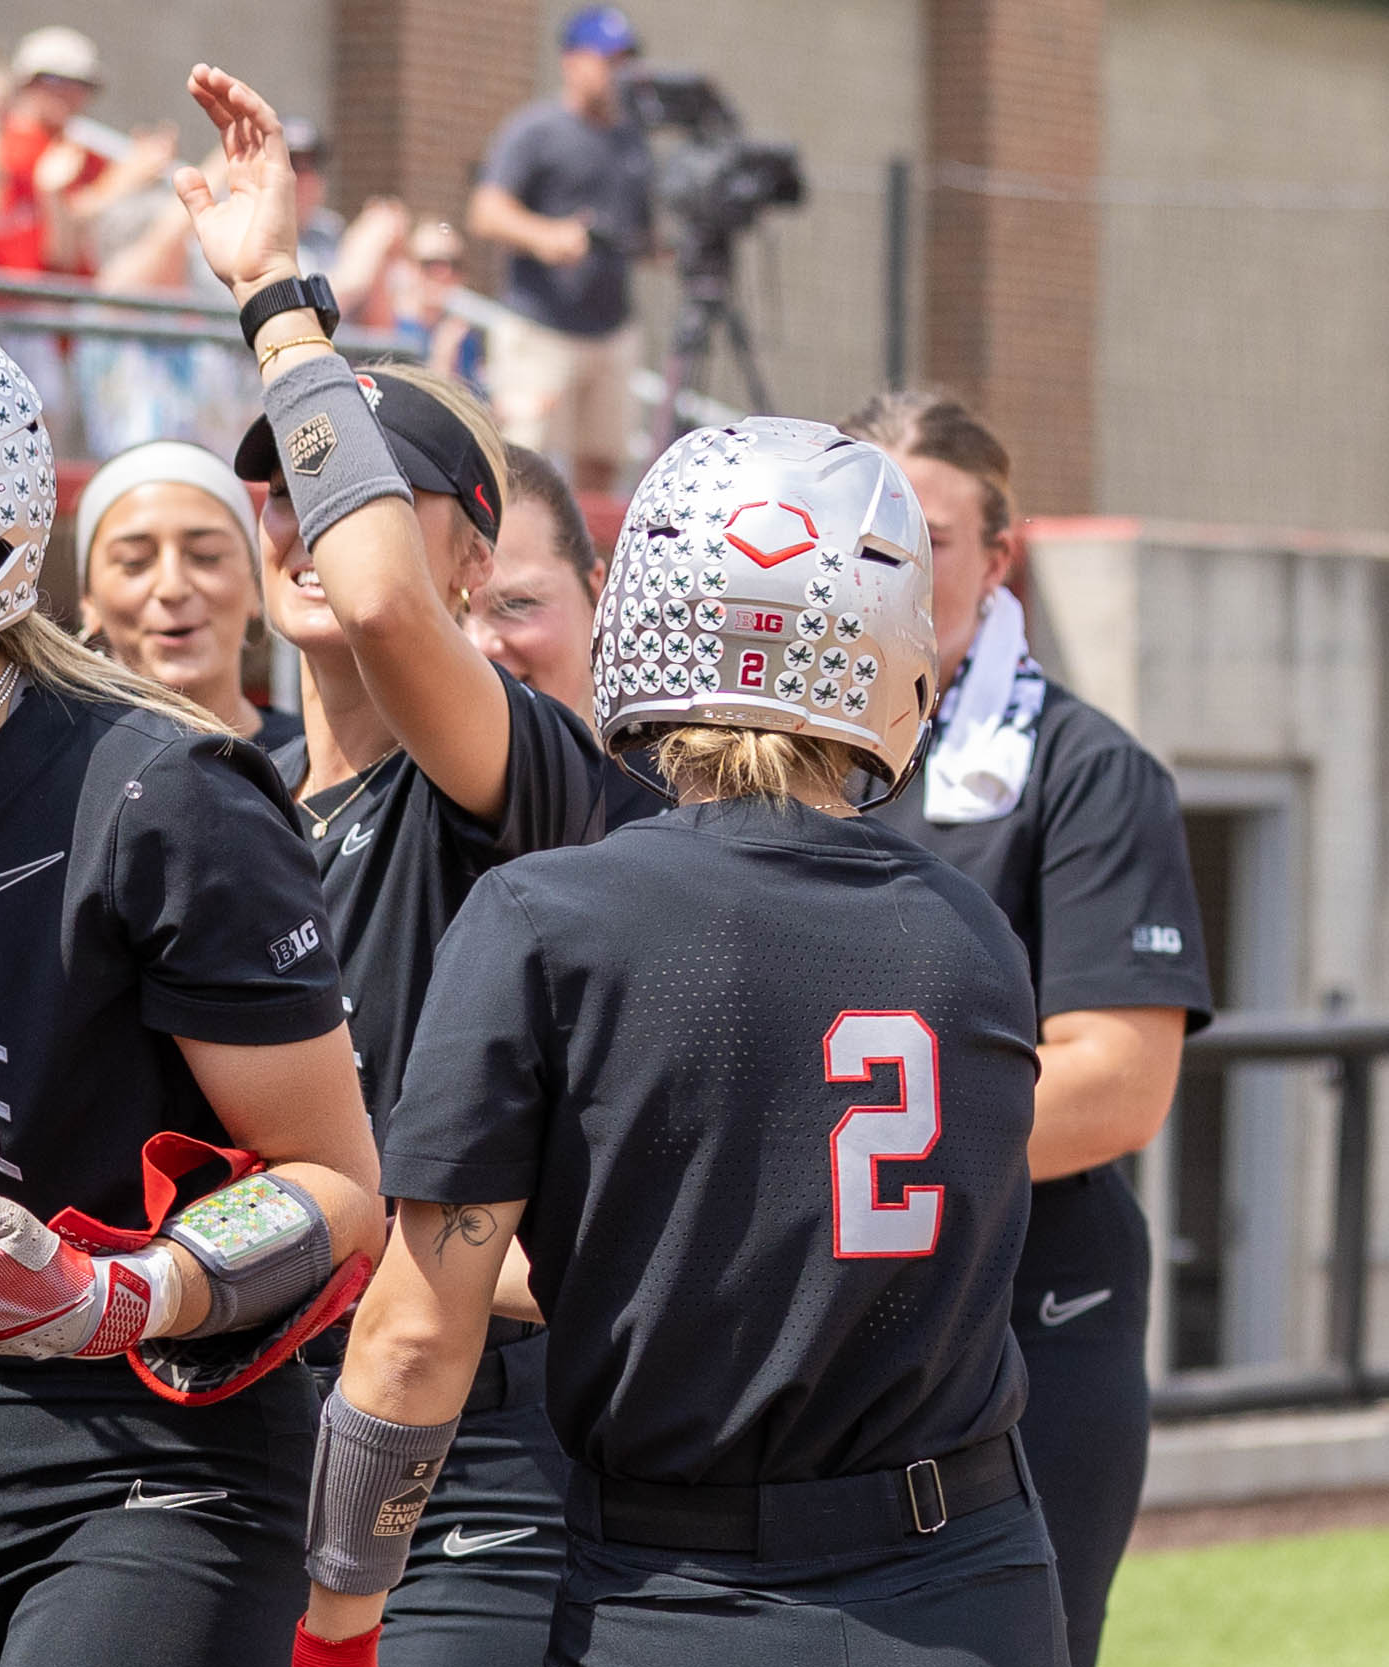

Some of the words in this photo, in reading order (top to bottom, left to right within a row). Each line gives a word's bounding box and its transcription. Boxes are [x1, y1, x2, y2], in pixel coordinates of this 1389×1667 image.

[289, 423, 331, 459] ZONE
[739, 651, 766, 689] 2
[822, 1010, 945, 1260] 2
